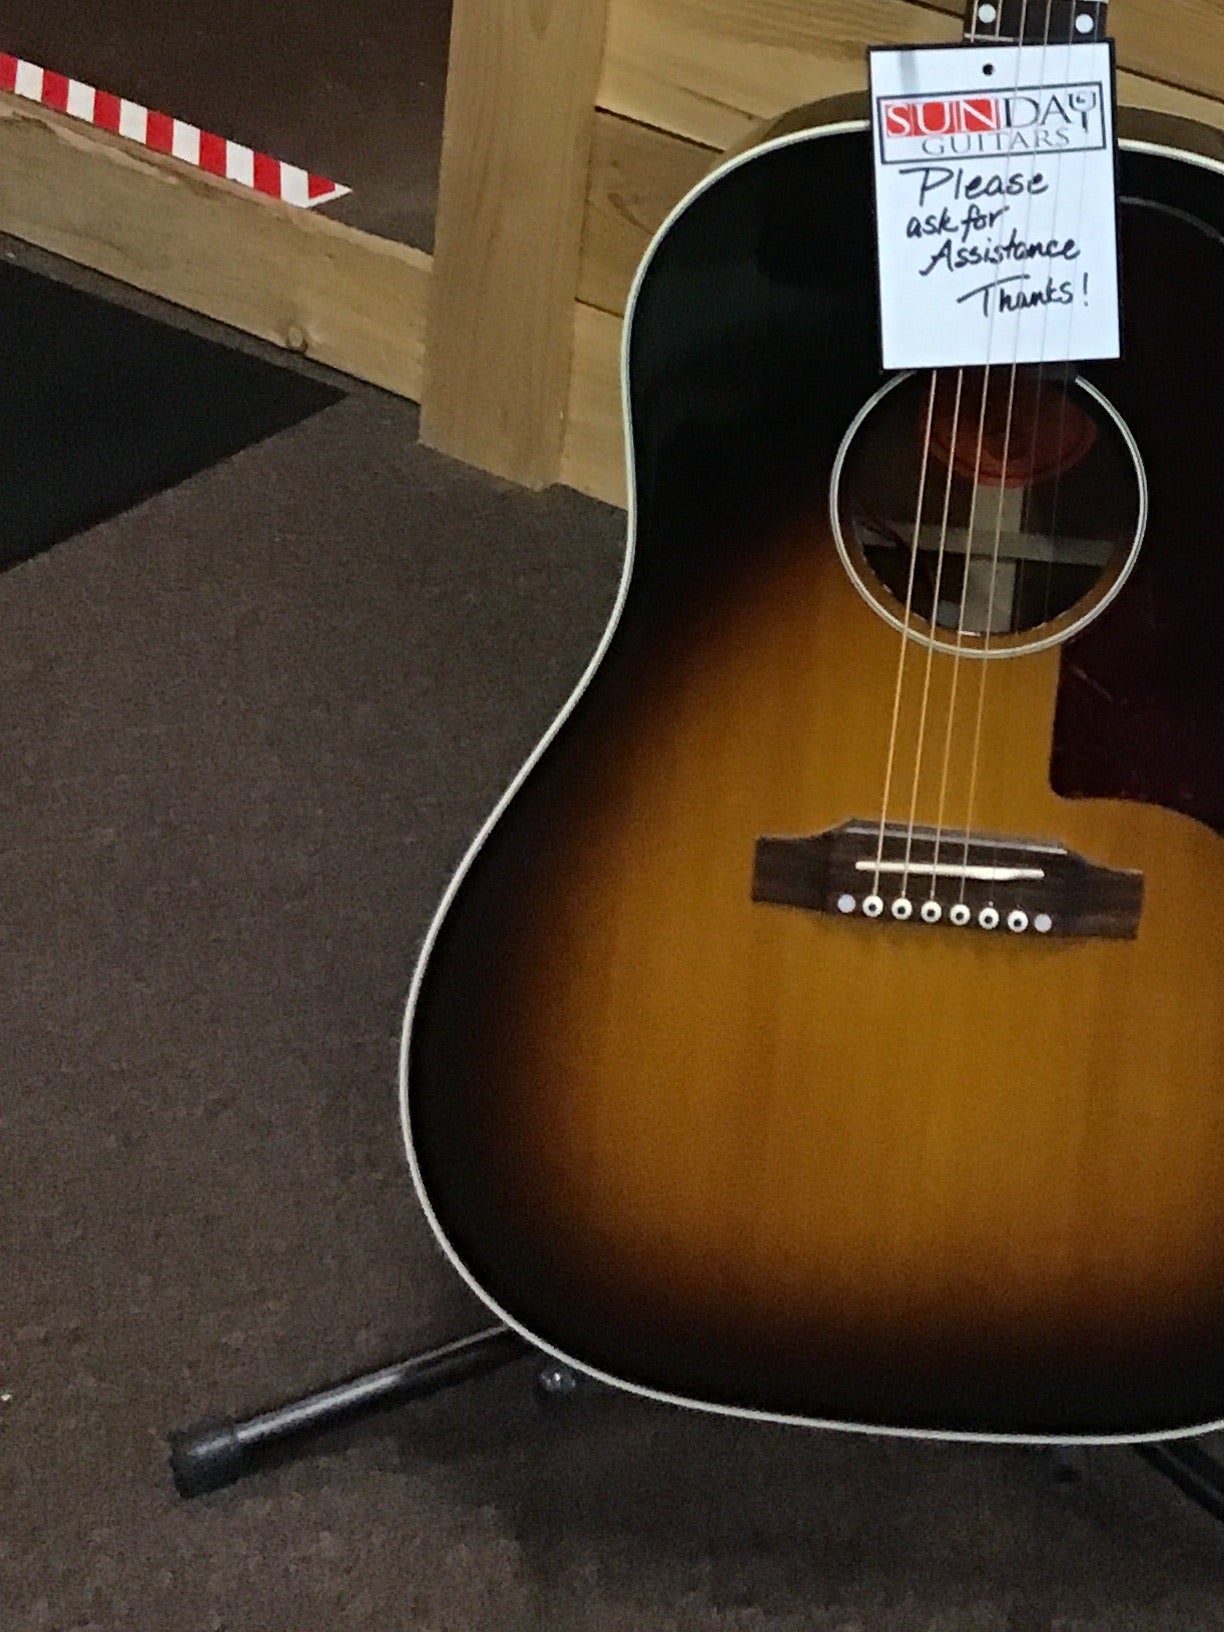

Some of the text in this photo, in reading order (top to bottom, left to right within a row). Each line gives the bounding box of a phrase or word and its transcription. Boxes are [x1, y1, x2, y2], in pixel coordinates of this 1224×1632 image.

[885, 89, 1097, 136] SUNDAY
[921, 126, 1071, 156] GUITARS
[898, 166, 1050, 207] Please
[906, 205, 1011, 242] ask for
[918, 228, 1081, 277] Assistance
[956, 272, 1090, 318] Thanks!
